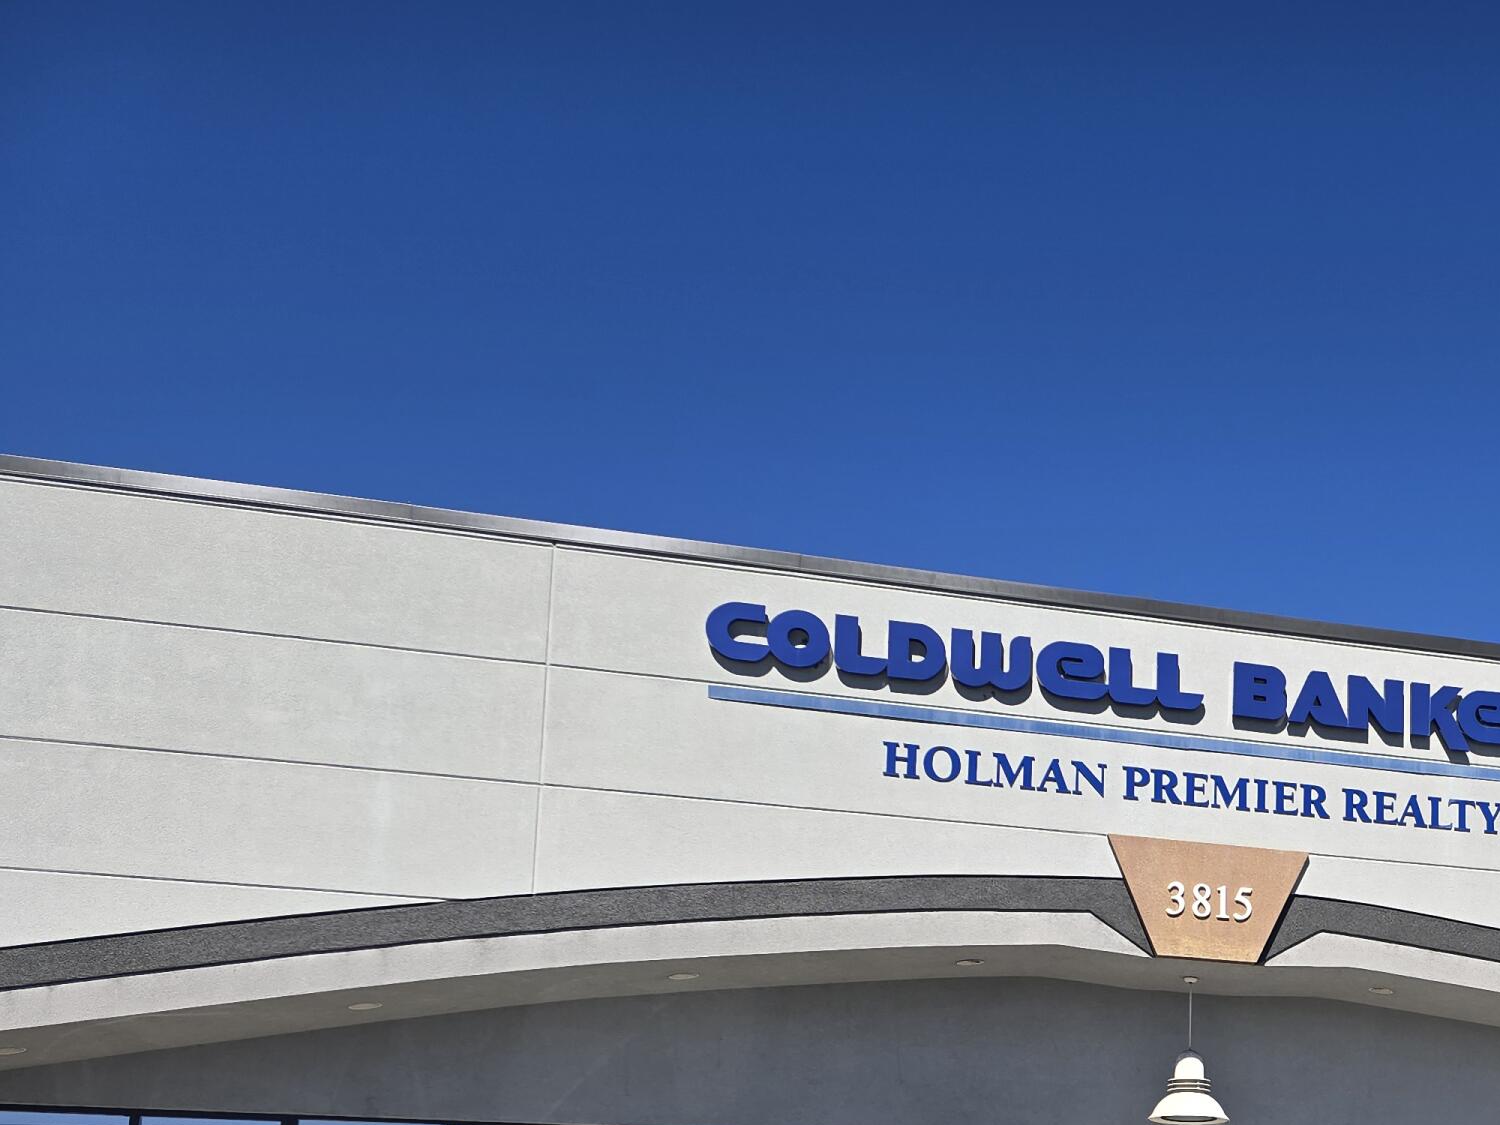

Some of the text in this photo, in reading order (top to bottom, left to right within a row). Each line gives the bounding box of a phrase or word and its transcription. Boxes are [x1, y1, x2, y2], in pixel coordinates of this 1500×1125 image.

[705, 601, 1203, 714] COLDWELL
[882, 741, 1107, 800] HOLMAN
[1123, 767, 1331, 818] PREMIER
[1165, 881, 1253, 921] 3815
